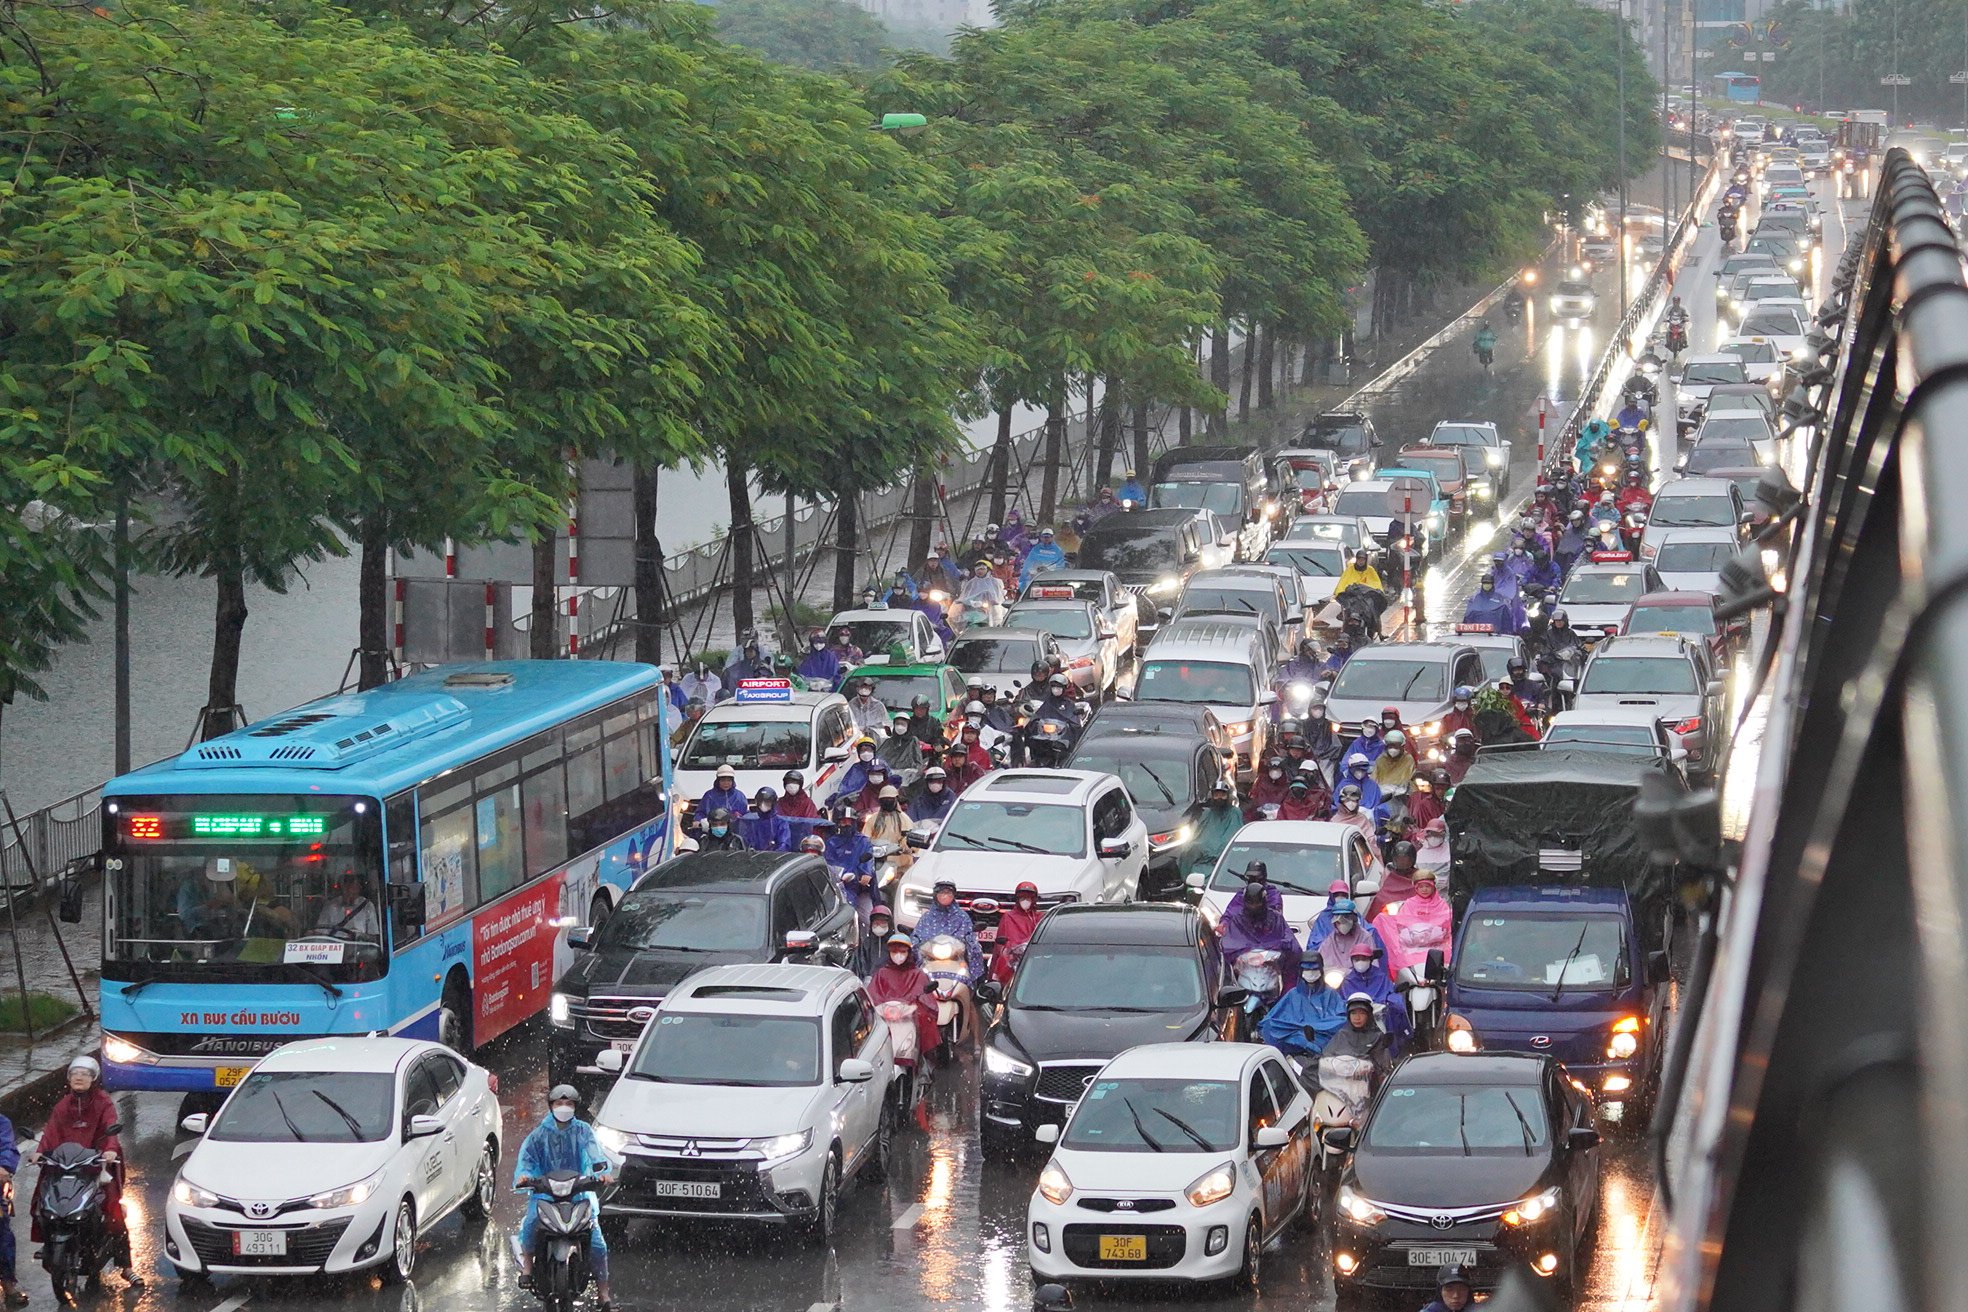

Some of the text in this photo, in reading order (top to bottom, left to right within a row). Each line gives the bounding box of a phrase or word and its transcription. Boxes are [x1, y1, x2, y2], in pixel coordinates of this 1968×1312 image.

[132, 817, 160, 837] 32
[287, 943, 298, 952] 32
[299, 944, 309, 952] BX
[180, 1012, 199, 1025] XN
[203, 1012, 227, 1025] BUS
[253, 1232, 273, 1243] 30G
[1113, 1237, 1133, 1248] 30F
